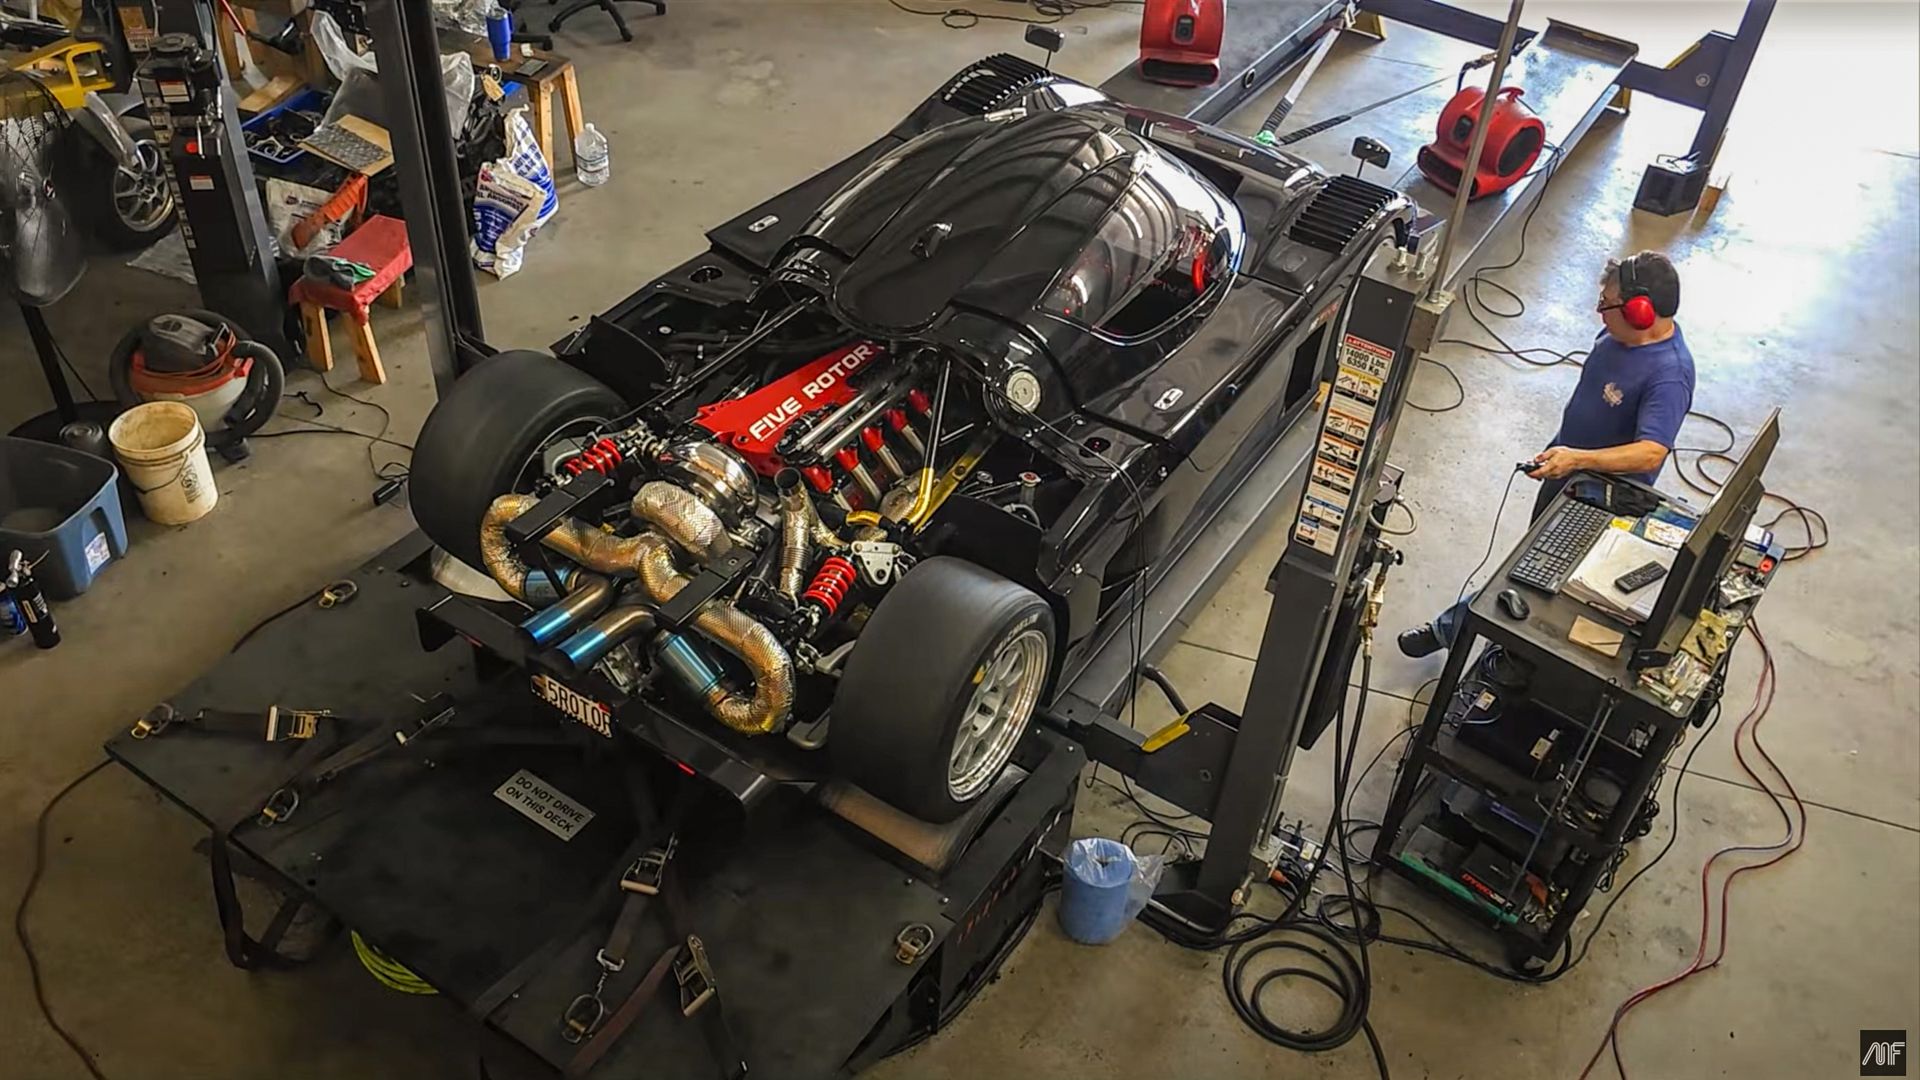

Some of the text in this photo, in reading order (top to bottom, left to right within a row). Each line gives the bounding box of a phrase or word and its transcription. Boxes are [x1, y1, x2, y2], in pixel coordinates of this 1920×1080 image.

[1346, 348, 1370, 362] 14000
[1347, 356, 1367, 370] 6350
[749, 345, 873, 440] FIVE ROTOR
[505, 786, 574, 832] ON THIS DECK
[515, 776, 585, 823] DO NOT DRIVE
